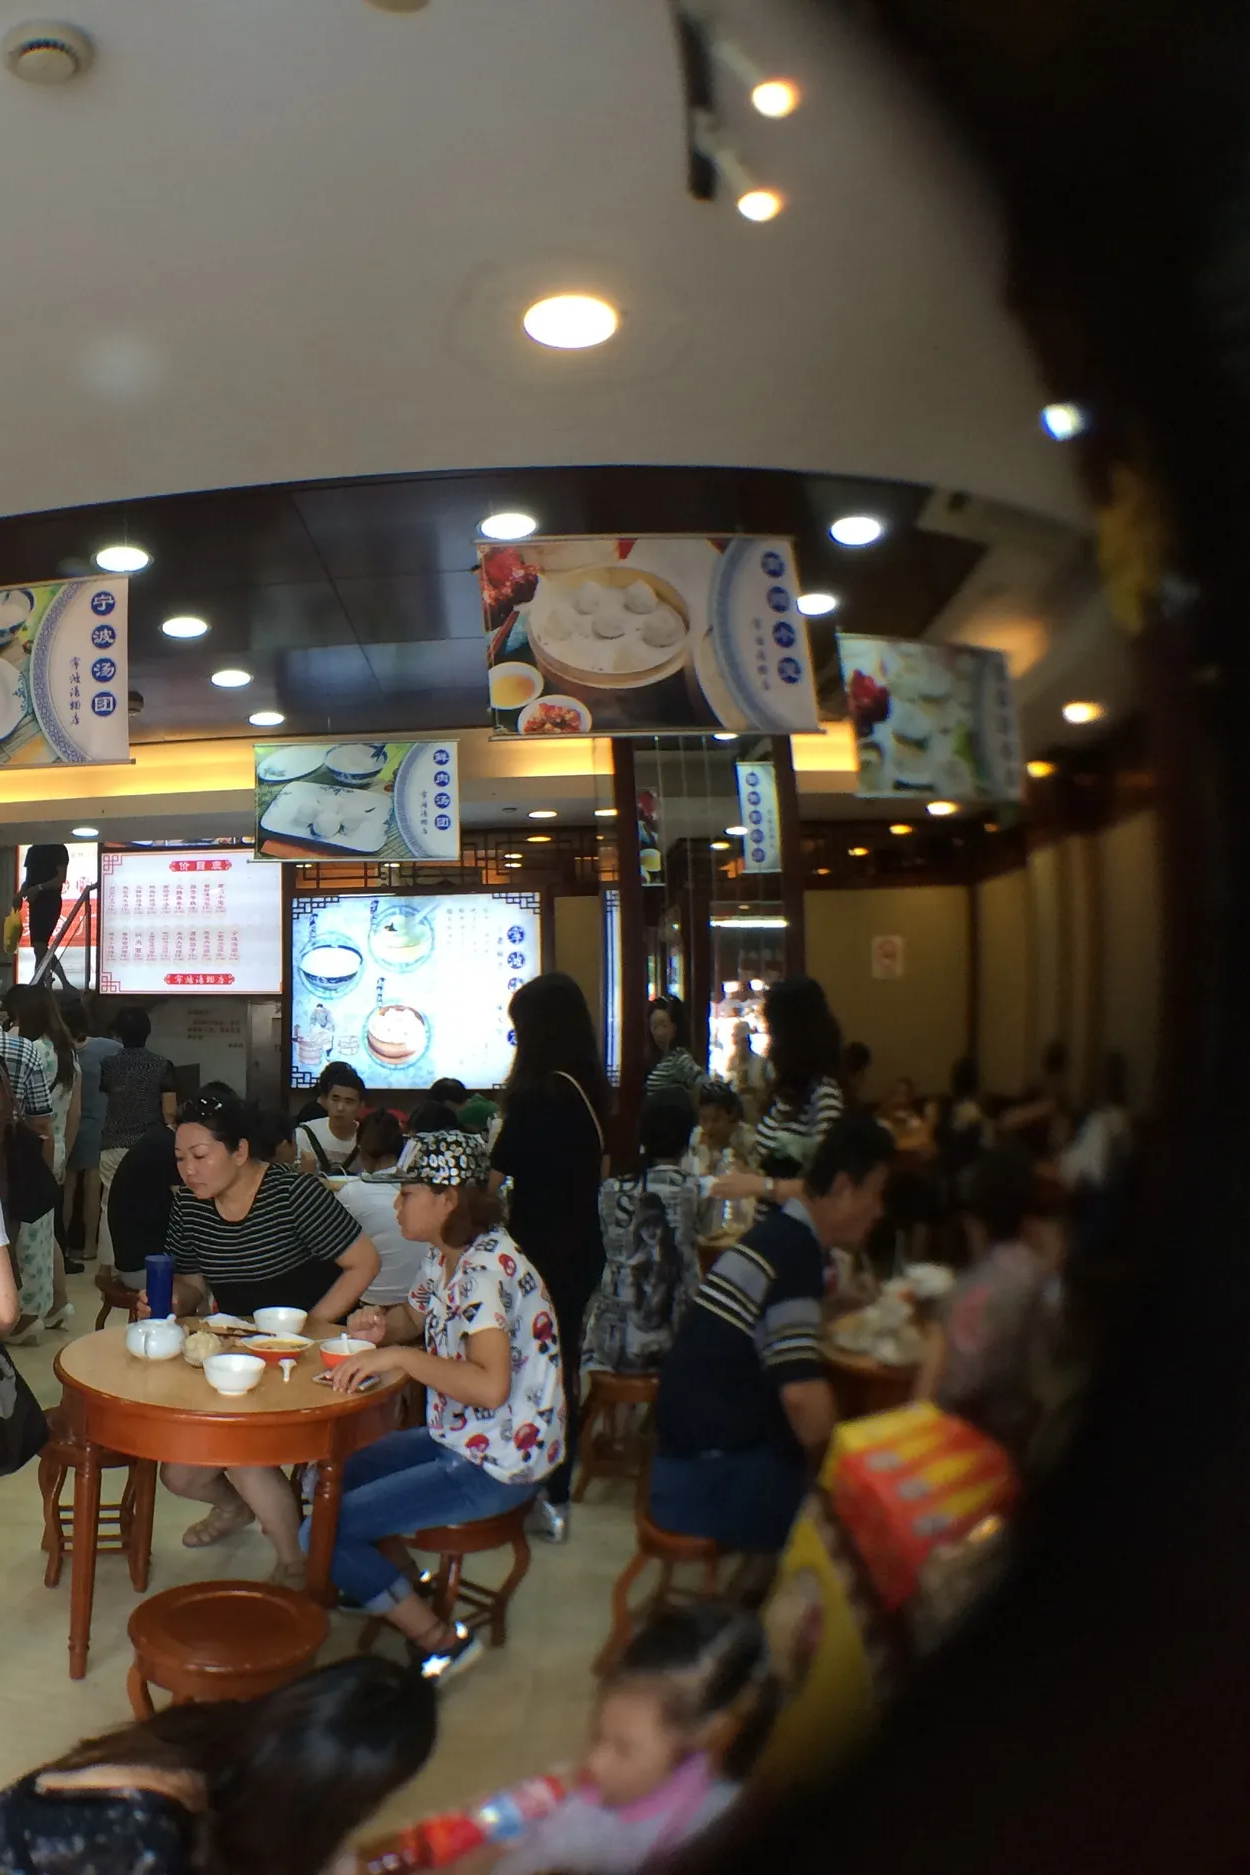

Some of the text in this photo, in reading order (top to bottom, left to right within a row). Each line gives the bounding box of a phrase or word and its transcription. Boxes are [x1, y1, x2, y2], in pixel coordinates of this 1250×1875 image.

[91, 592, 116, 715] 宁波汤团
[433, 749, 451, 831] 鲜肉汤团
